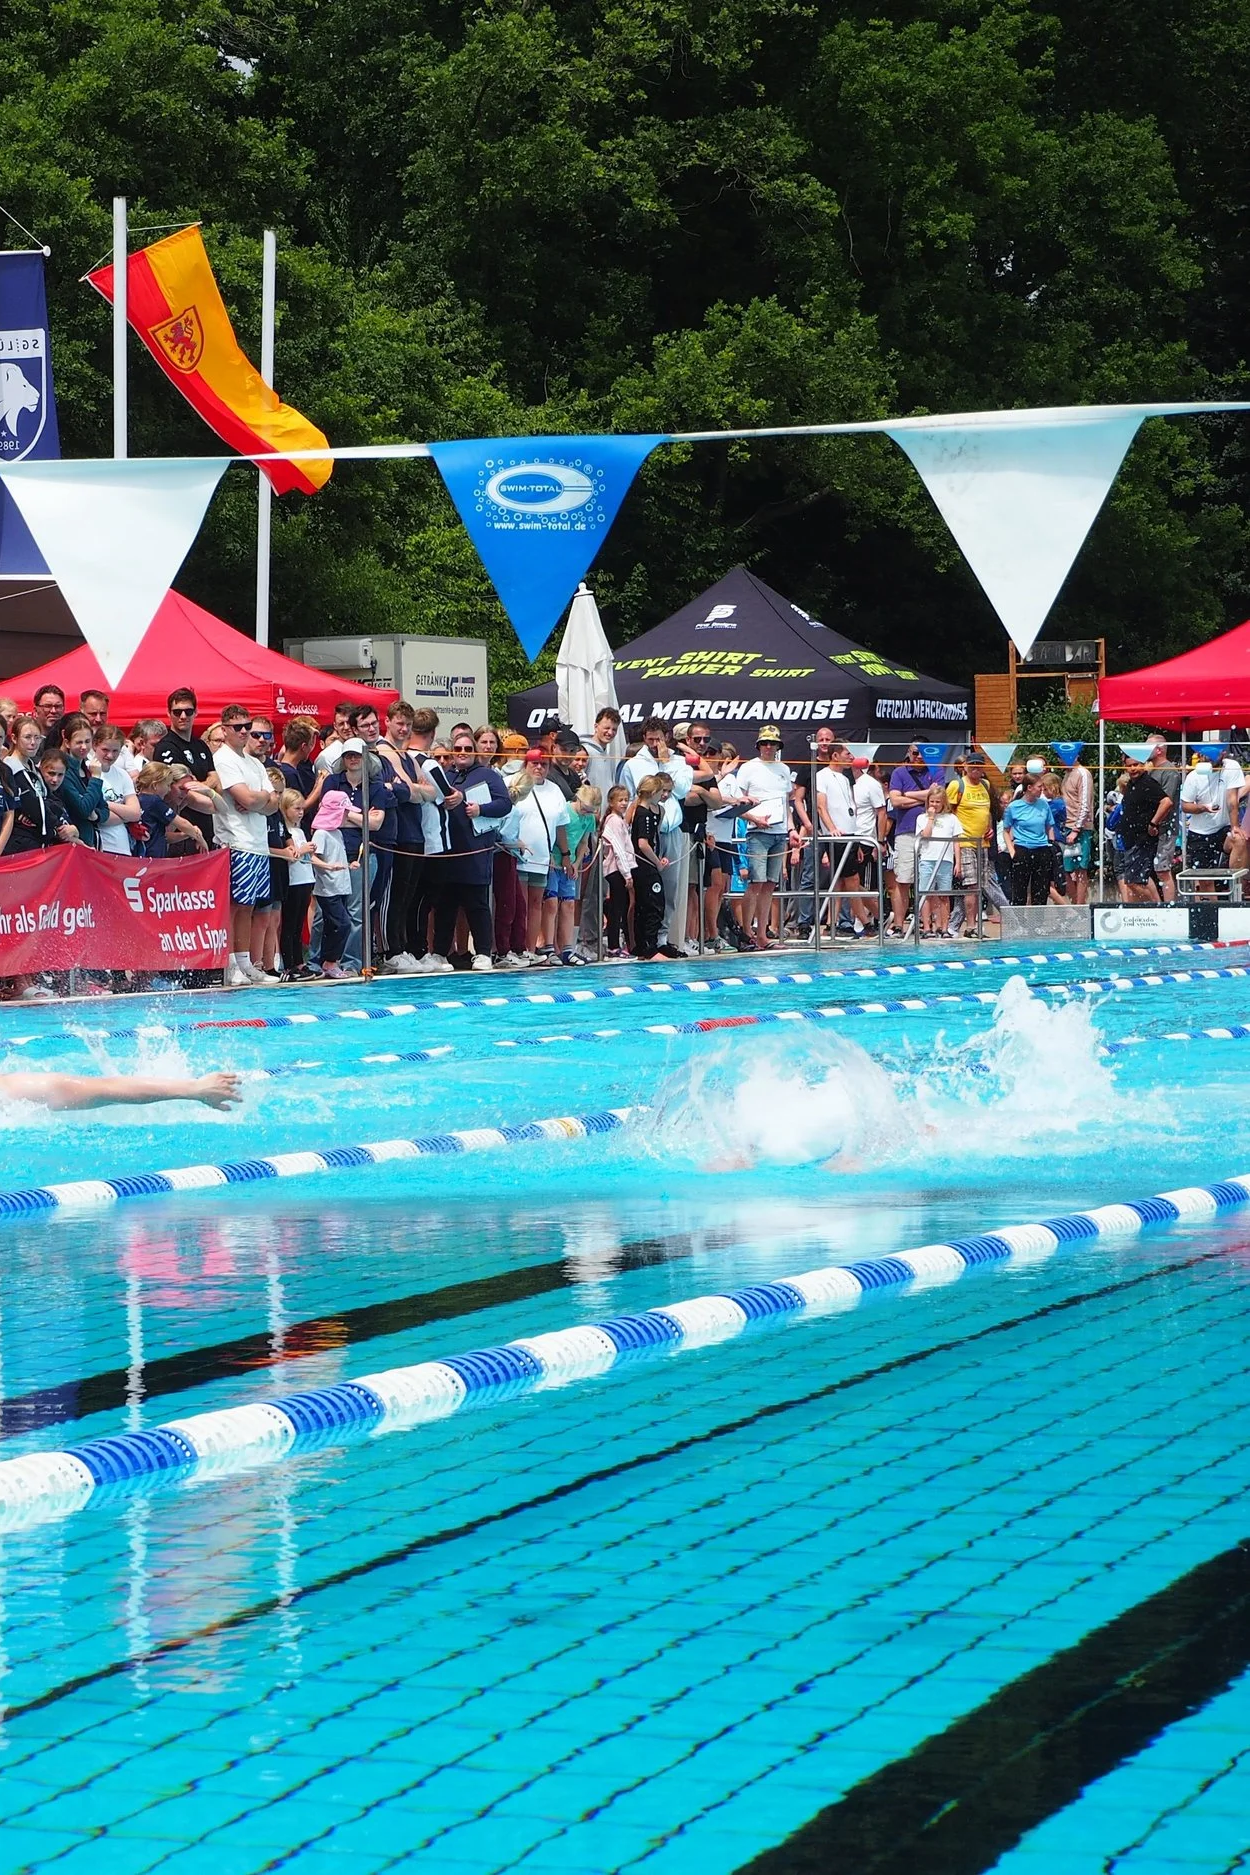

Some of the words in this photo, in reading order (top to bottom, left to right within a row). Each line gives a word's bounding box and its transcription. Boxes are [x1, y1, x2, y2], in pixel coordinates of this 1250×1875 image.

[500, 484, 562, 493] SWIM-TOTAL
[493, 521, 587, 531] www.swim-total.de
[613, 656, 672, 671] VENT
[676, 651, 762, 665] SHIRT
[1065, 643, 1091, 662] BAR
[641, 663, 743, 680] POWER
[749, 668, 816, 679] SHIRT
[651, 699, 849, 722] MERCHANDISE
[876, 699, 912, 719] OFFICIAL
[913, 699, 968, 720] MERCHANDISE
[147, 885, 216, 919] Sparkasse
[15, 905, 37, 934] als
[158, 932, 175, 952] an
[174, 925, 198, 951] der
[196, 923, 228, 955] Lippe
